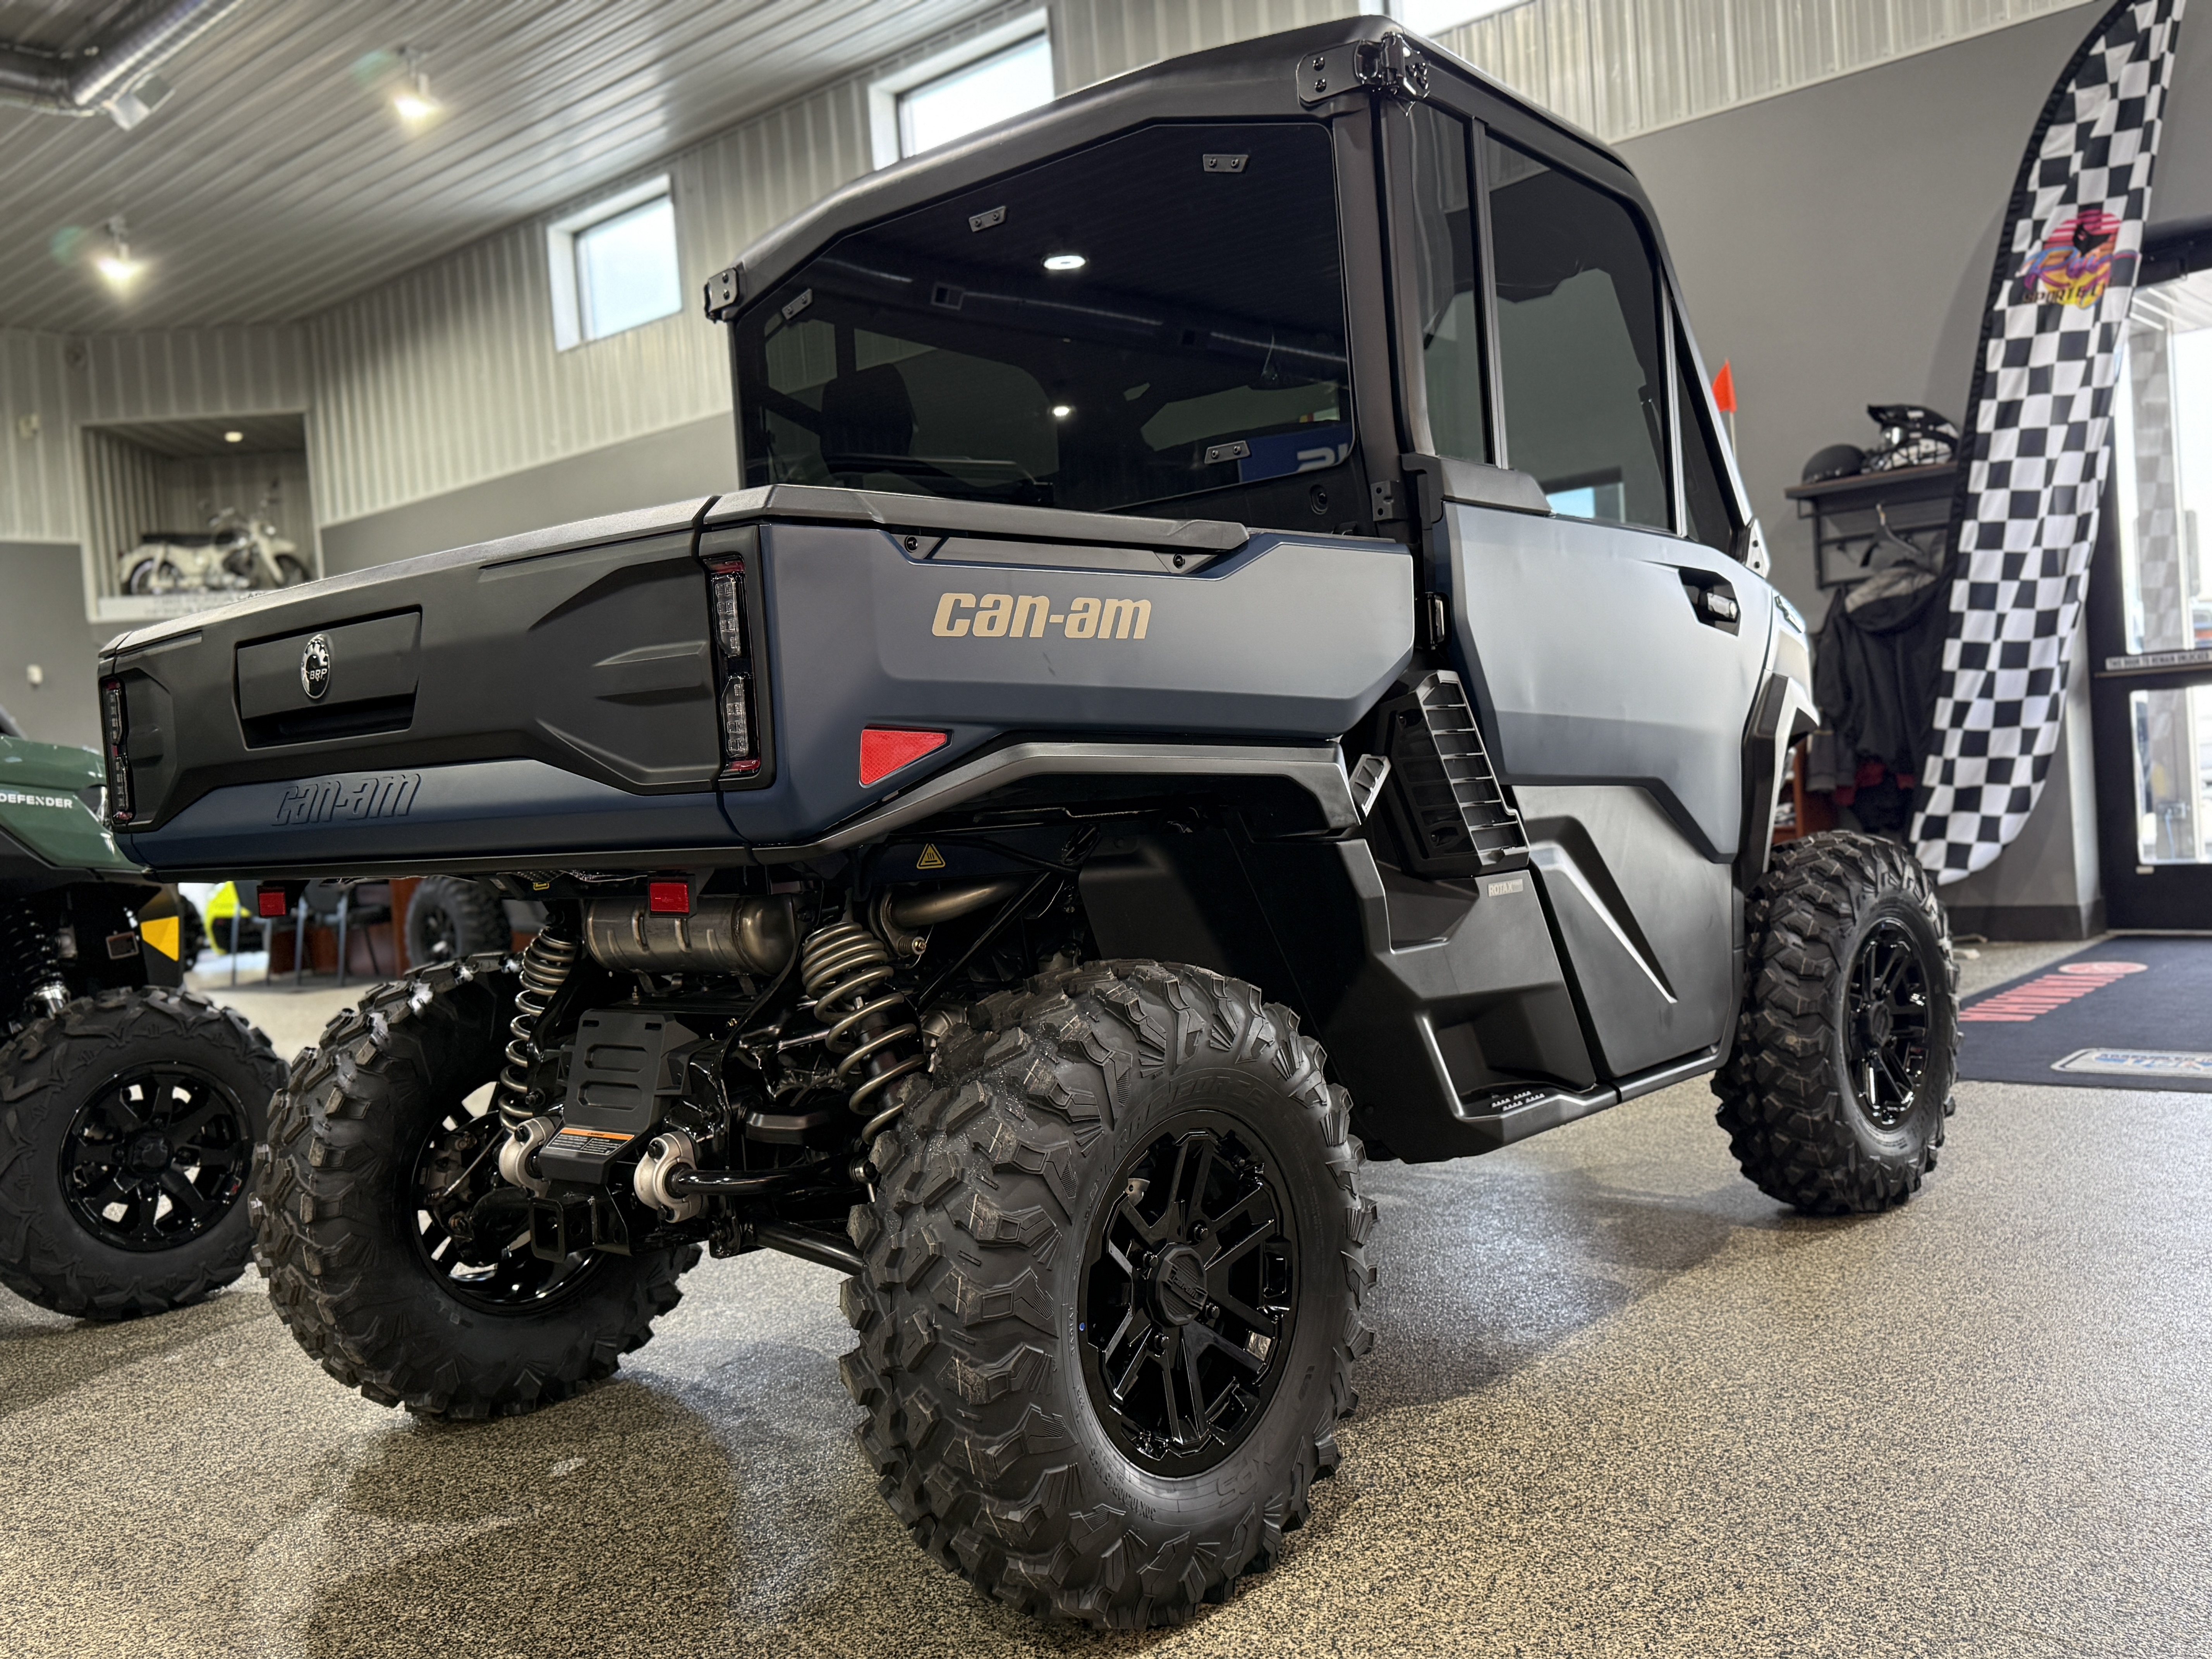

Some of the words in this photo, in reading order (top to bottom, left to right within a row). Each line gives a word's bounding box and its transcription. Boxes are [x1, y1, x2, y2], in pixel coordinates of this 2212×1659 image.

[932, 593, 1151, 639] can-am
[309, 668, 327, 680] BRP
[0, 793, 72, 809] DEFENDER
[271, 773, 421, 826] can-am
[1489, 882, 1513, 896] ROTAX
